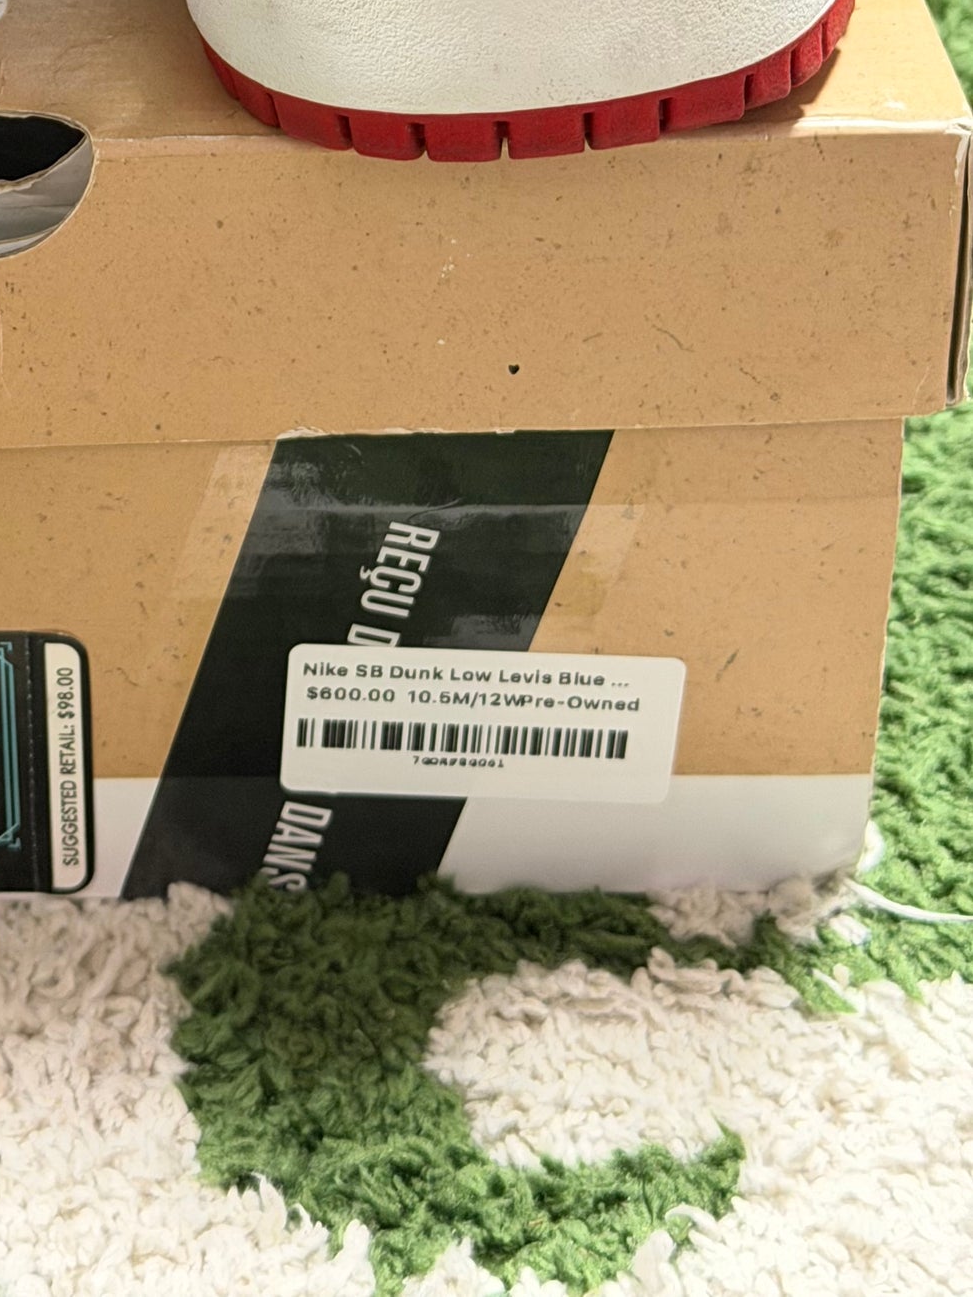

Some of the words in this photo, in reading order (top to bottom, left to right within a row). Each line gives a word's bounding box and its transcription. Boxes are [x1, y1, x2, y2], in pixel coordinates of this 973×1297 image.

[359, 520, 440, 619] REÇU
[55, 666, 75, 720] $98.00
[302, 662, 348, 677] Nike
[356, 664, 383, 678] SB
[389, 665, 443, 681] Dunk
[450, 668, 492, 682] Low
[498, 669, 552, 684] Levis
[559, 672, 605, 687] Blue
[306, 687, 395, 702] $600.00
[58, 724, 77, 775] RETAIL:
[60, 779, 79, 867] SUGGESTED
